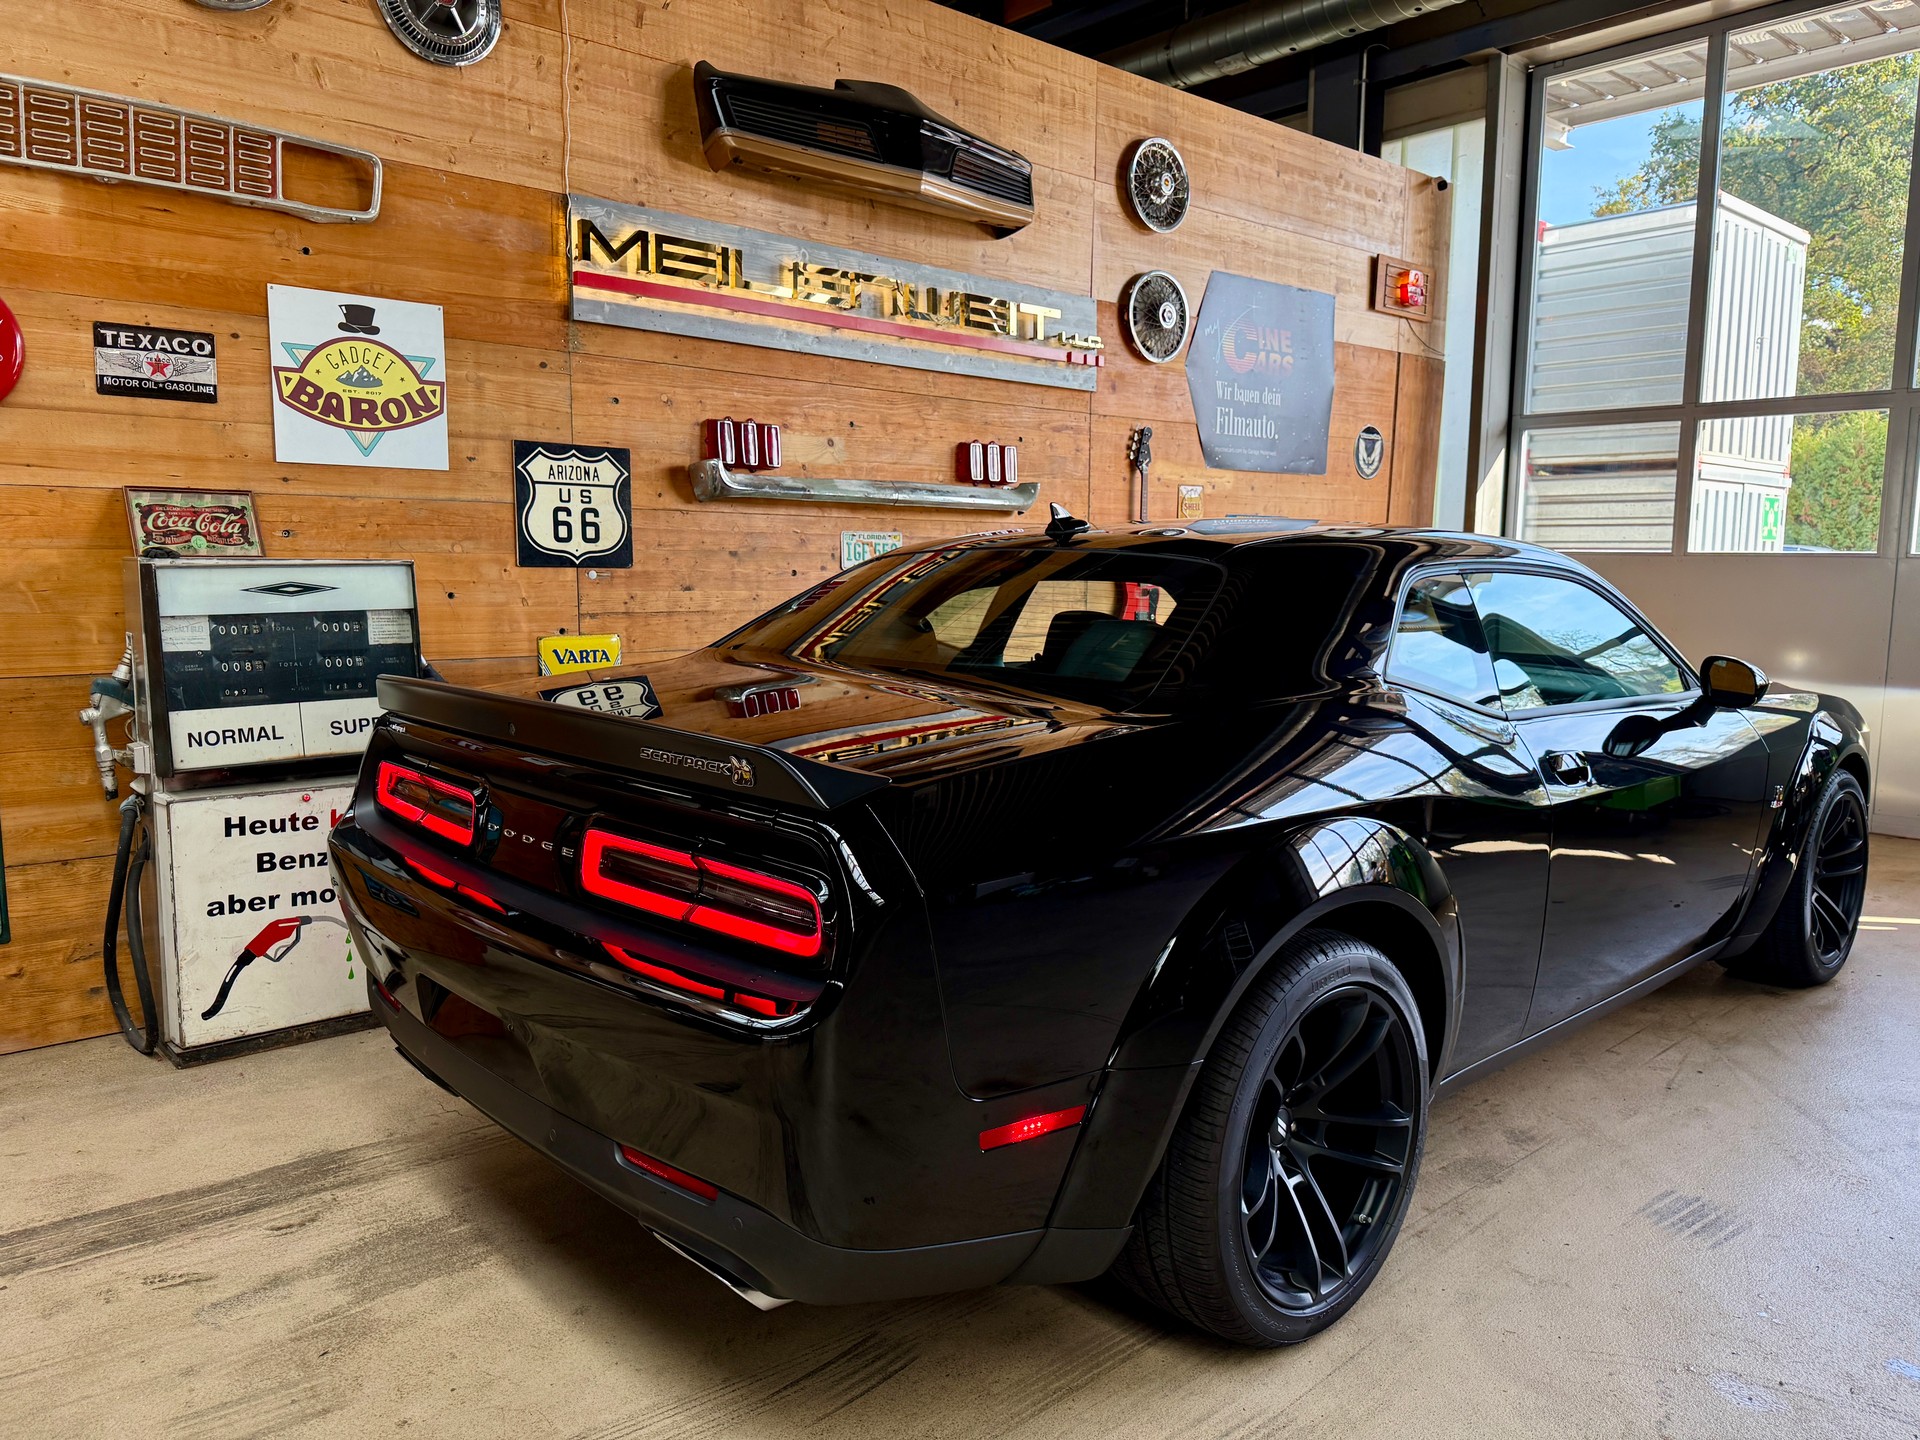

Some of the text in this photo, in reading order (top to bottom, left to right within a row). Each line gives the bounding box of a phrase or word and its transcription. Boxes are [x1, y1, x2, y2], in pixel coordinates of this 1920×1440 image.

[99, 328, 212, 356] TEXACO
[325, 346, 396, 374] GADGET
[103, 376, 214, 395] MOTOR OIL GASOLINE
[1216, 380, 1281, 406] Wir bauen dein
[285, 375, 439, 426] BARON
[1216, 406, 1279, 440] Filmauto.
[548, 464, 600, 482] ARIZONA
[552, 506, 600, 544] 66
[551, 648, 612, 665] VARTA
[187, 725, 285, 748] NORMAL
[640, 747, 732, 776] SCAT PACK
[224, 812, 320, 838] Heute
[487, 822, 575, 858] DODGE
[206, 893, 280, 917] aber
